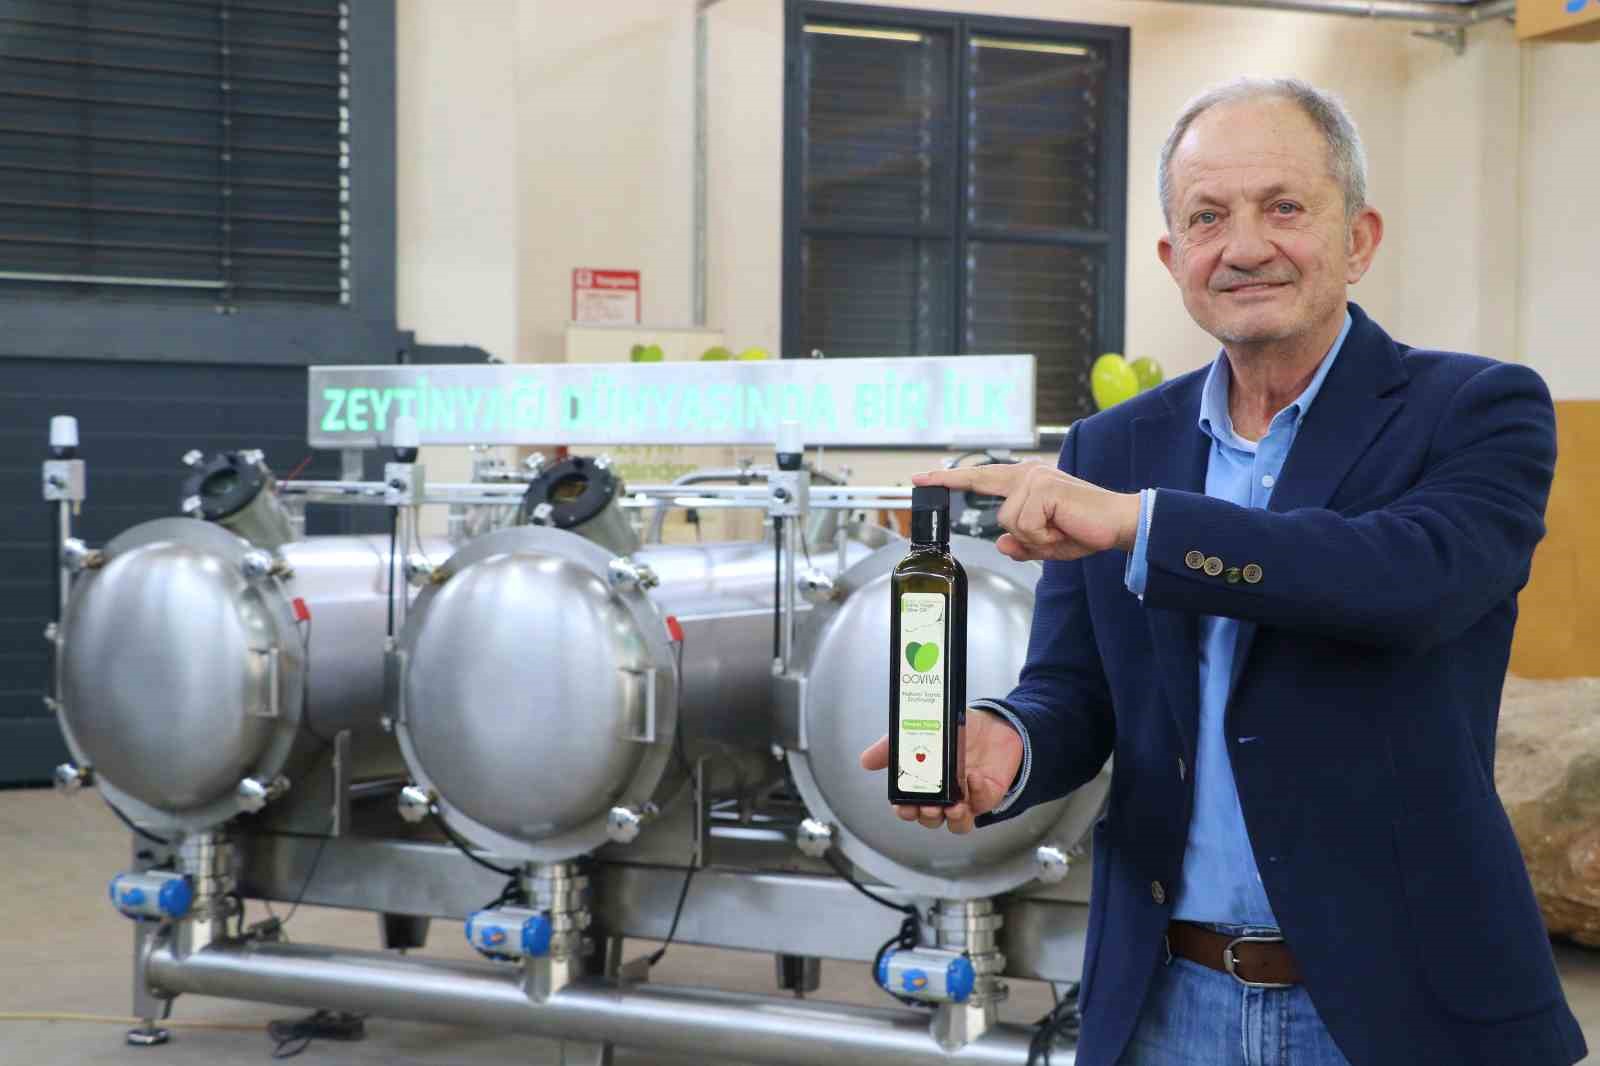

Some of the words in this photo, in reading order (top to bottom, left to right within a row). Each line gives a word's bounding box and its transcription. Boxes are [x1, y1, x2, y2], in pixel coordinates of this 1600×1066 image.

[561, 370, 839, 432] DÜNYASINDA
[855, 368, 930, 430] BİR
[944, 367, 1015, 428] İLK
[902, 673, 942, 685] OOVIVA
